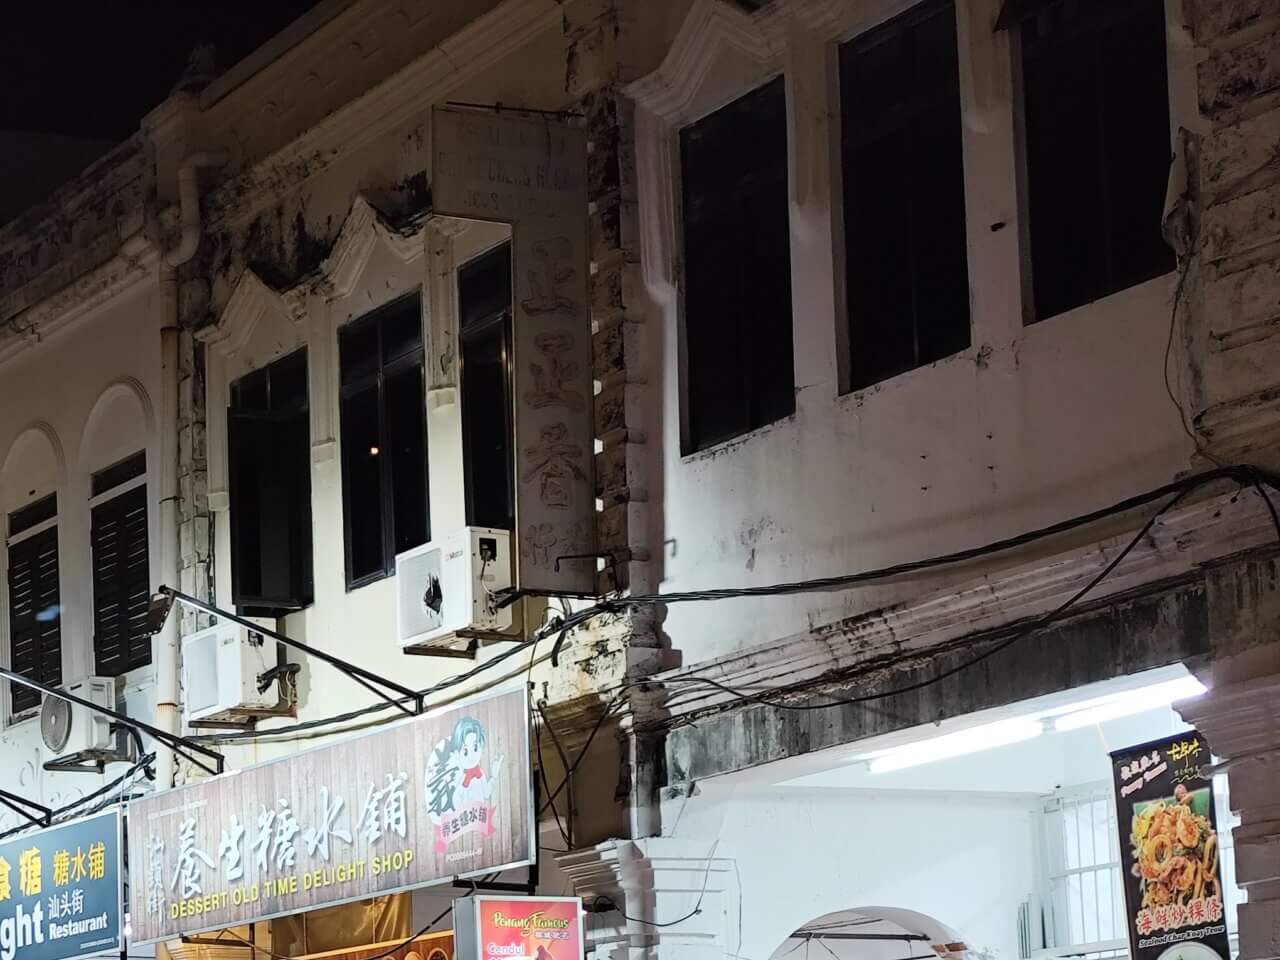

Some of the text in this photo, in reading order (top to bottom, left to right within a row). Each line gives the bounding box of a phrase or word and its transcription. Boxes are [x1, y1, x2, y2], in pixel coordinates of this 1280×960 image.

[170, 849, 414, 920] DESSERT OLD TIME DELIGHT SHOP
[48, 888, 84, 921] 汕头街
[49, 912, 108, 941] Restaurant
[493, 912, 530, 936] Penang
[530, 911, 569, 929] Famous
[487, 942, 525, 955] Cendul
[1139, 936, 1167, 948] Seafood
